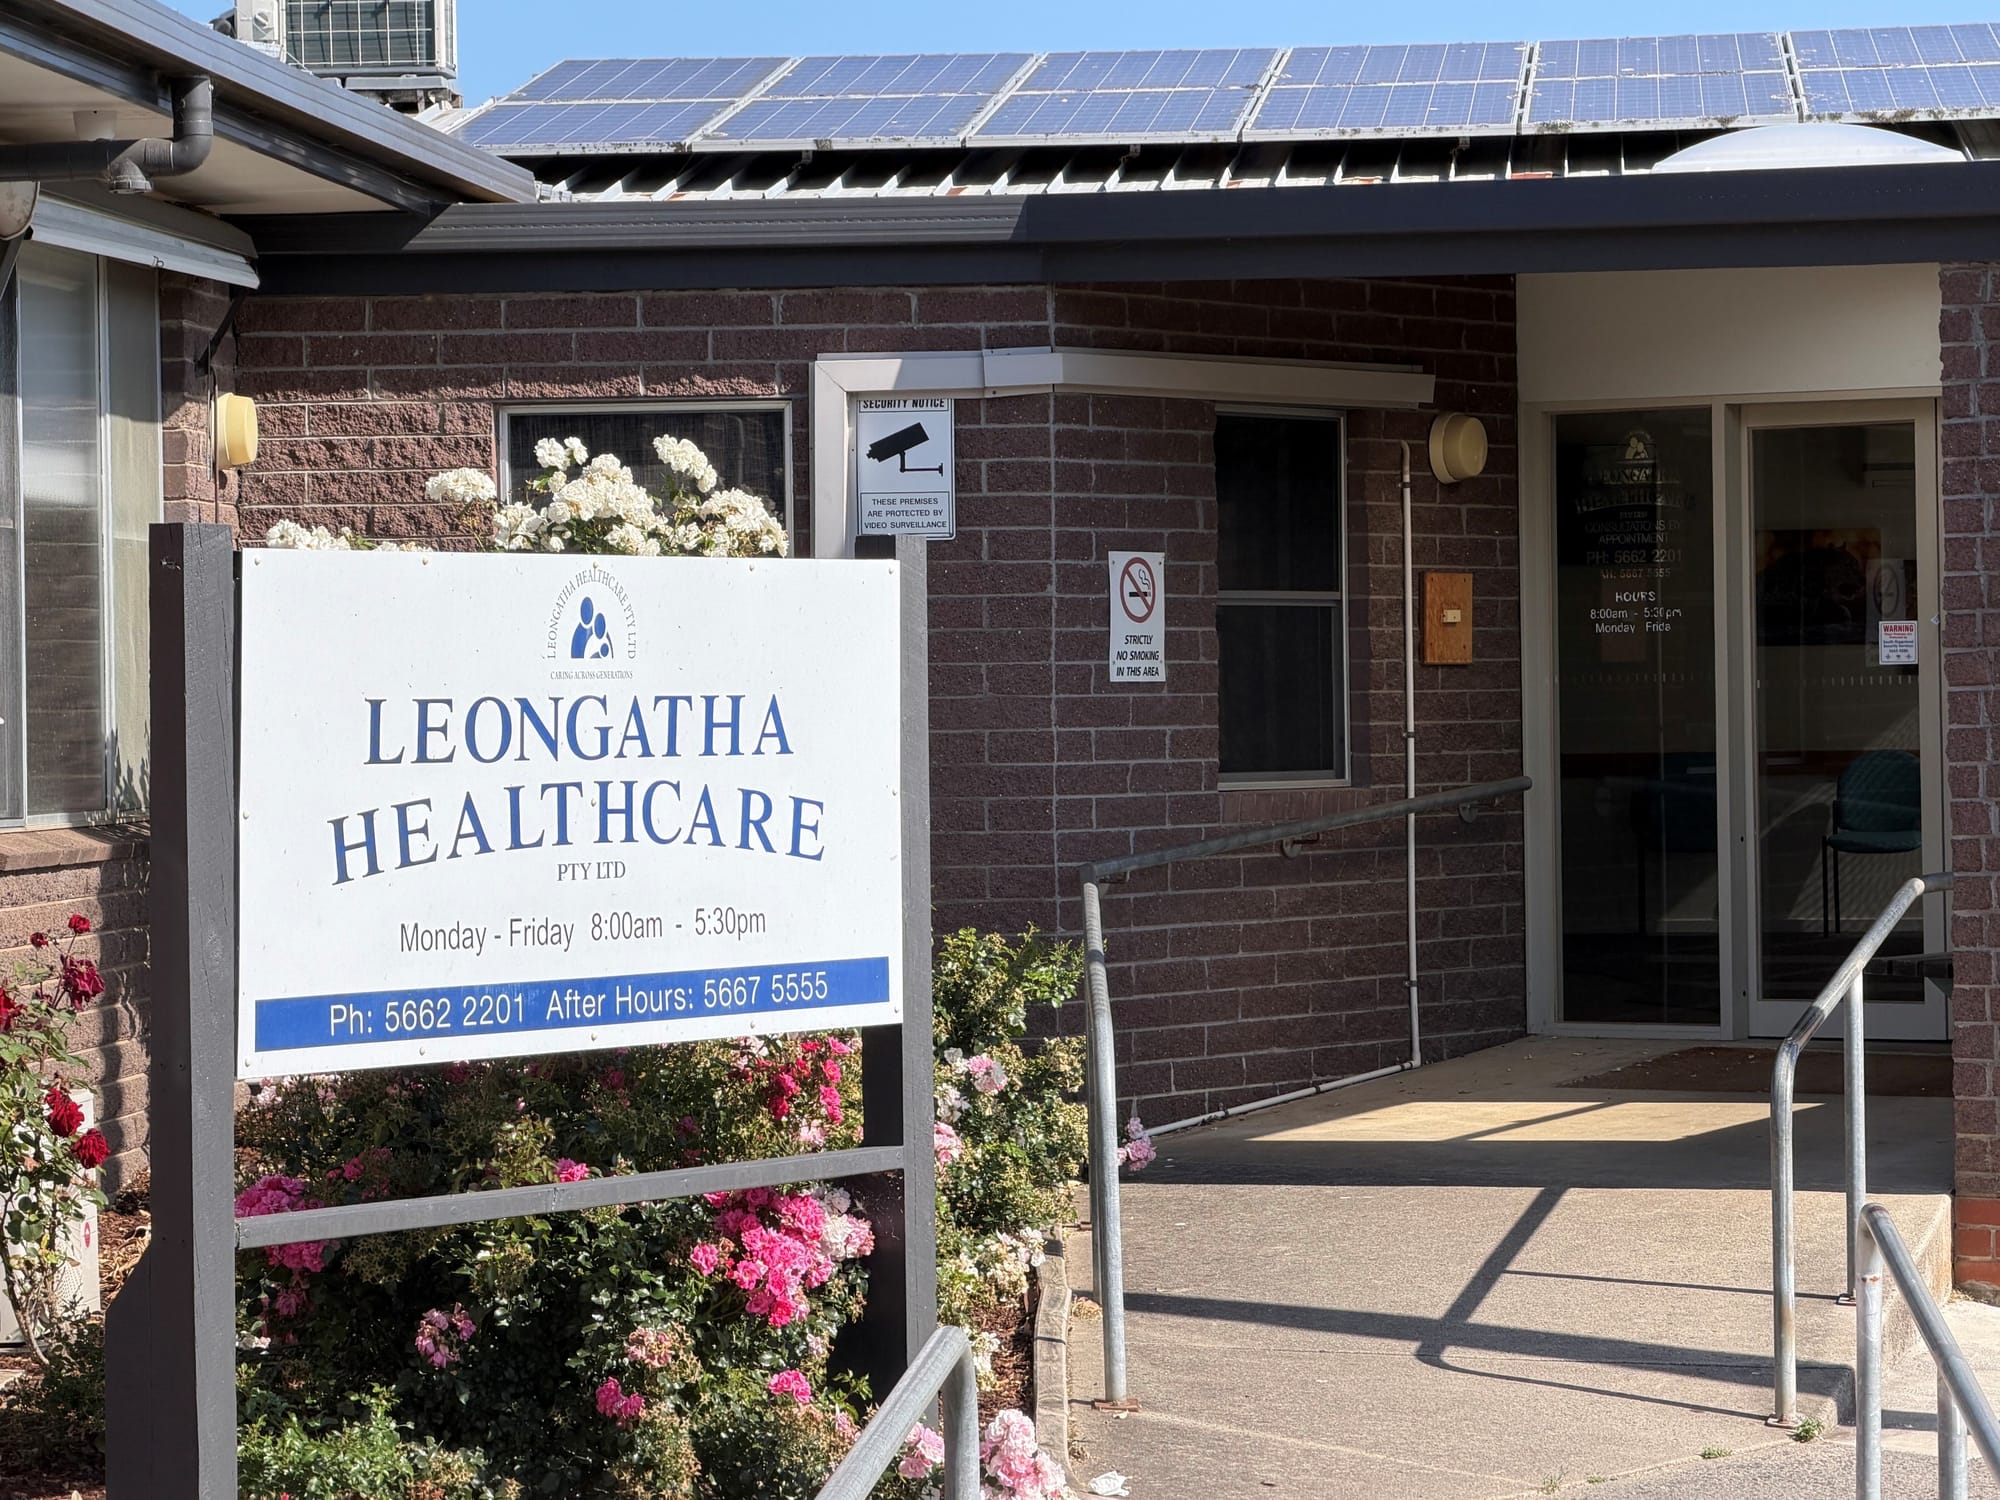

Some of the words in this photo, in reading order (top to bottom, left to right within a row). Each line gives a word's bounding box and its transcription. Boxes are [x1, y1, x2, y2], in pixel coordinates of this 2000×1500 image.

[863, 399, 908, 409] SECURITY
[912, 399, 944, 408] NOTICE
[872, 498, 896, 506] THESE
[900, 497, 938, 506] PREMISES
[868, 510, 882, 518] ARE
[886, 509, 930, 517] PROTECTED
[890, 520, 947, 528] SURVEILLANCE
[1599, 533, 1669, 545] APPOINTMENT
[1614, 550, 1647, 564] 5662
[1652, 549, 1682, 562] 2201
[576, 568, 628, 606] HEALTHCARE
[1615, 591, 1656, 602] HOURS
[547, 580, 576, 660] LEONGATHA
[624, 603, 636, 628] PTY
[1590, 608, 1628, 620] 8:00am
[1595, 622, 1636, 634] Monday
[1883, 624, 1914, 632] WARNING
[627, 632, 636, 660] LTD
[1124, 635, 1152, 645] STRICTLY
[1116, 650, 1128, 661] NO
[1129, 650, 1160, 661] SMOKING
[550, 670, 574, 680] CARING
[574, 670, 596, 680] ACROSS
[596, 670, 633, 680] GENERATIONS
[1116, 667, 1125, 676] IN
[1126, 666, 1142, 676] THIS
[1142, 666, 1160, 676] AREA
[363, 694, 794, 765] LEONGATHA
[327, 779, 826, 886] HEALTHCARE
[557, 862, 592, 881] PTY
[596, 861, 626, 879] LTD
[400, 921, 487, 957] Monday
[509, 918, 575, 952] Friday
[591, 912, 663, 942] 8:00am
[695, 907, 767, 940] 5:30pm
[330, 1003, 373, 1037] Ph:
[384, 997, 452, 1032] 5662
[463, 992, 524, 1026] 2201
[546, 989, 606, 1021] After
[615, 984, 694, 1016] Hours:
[703, 976, 761, 1008] 5667
[771, 971, 828, 1003] 5555
